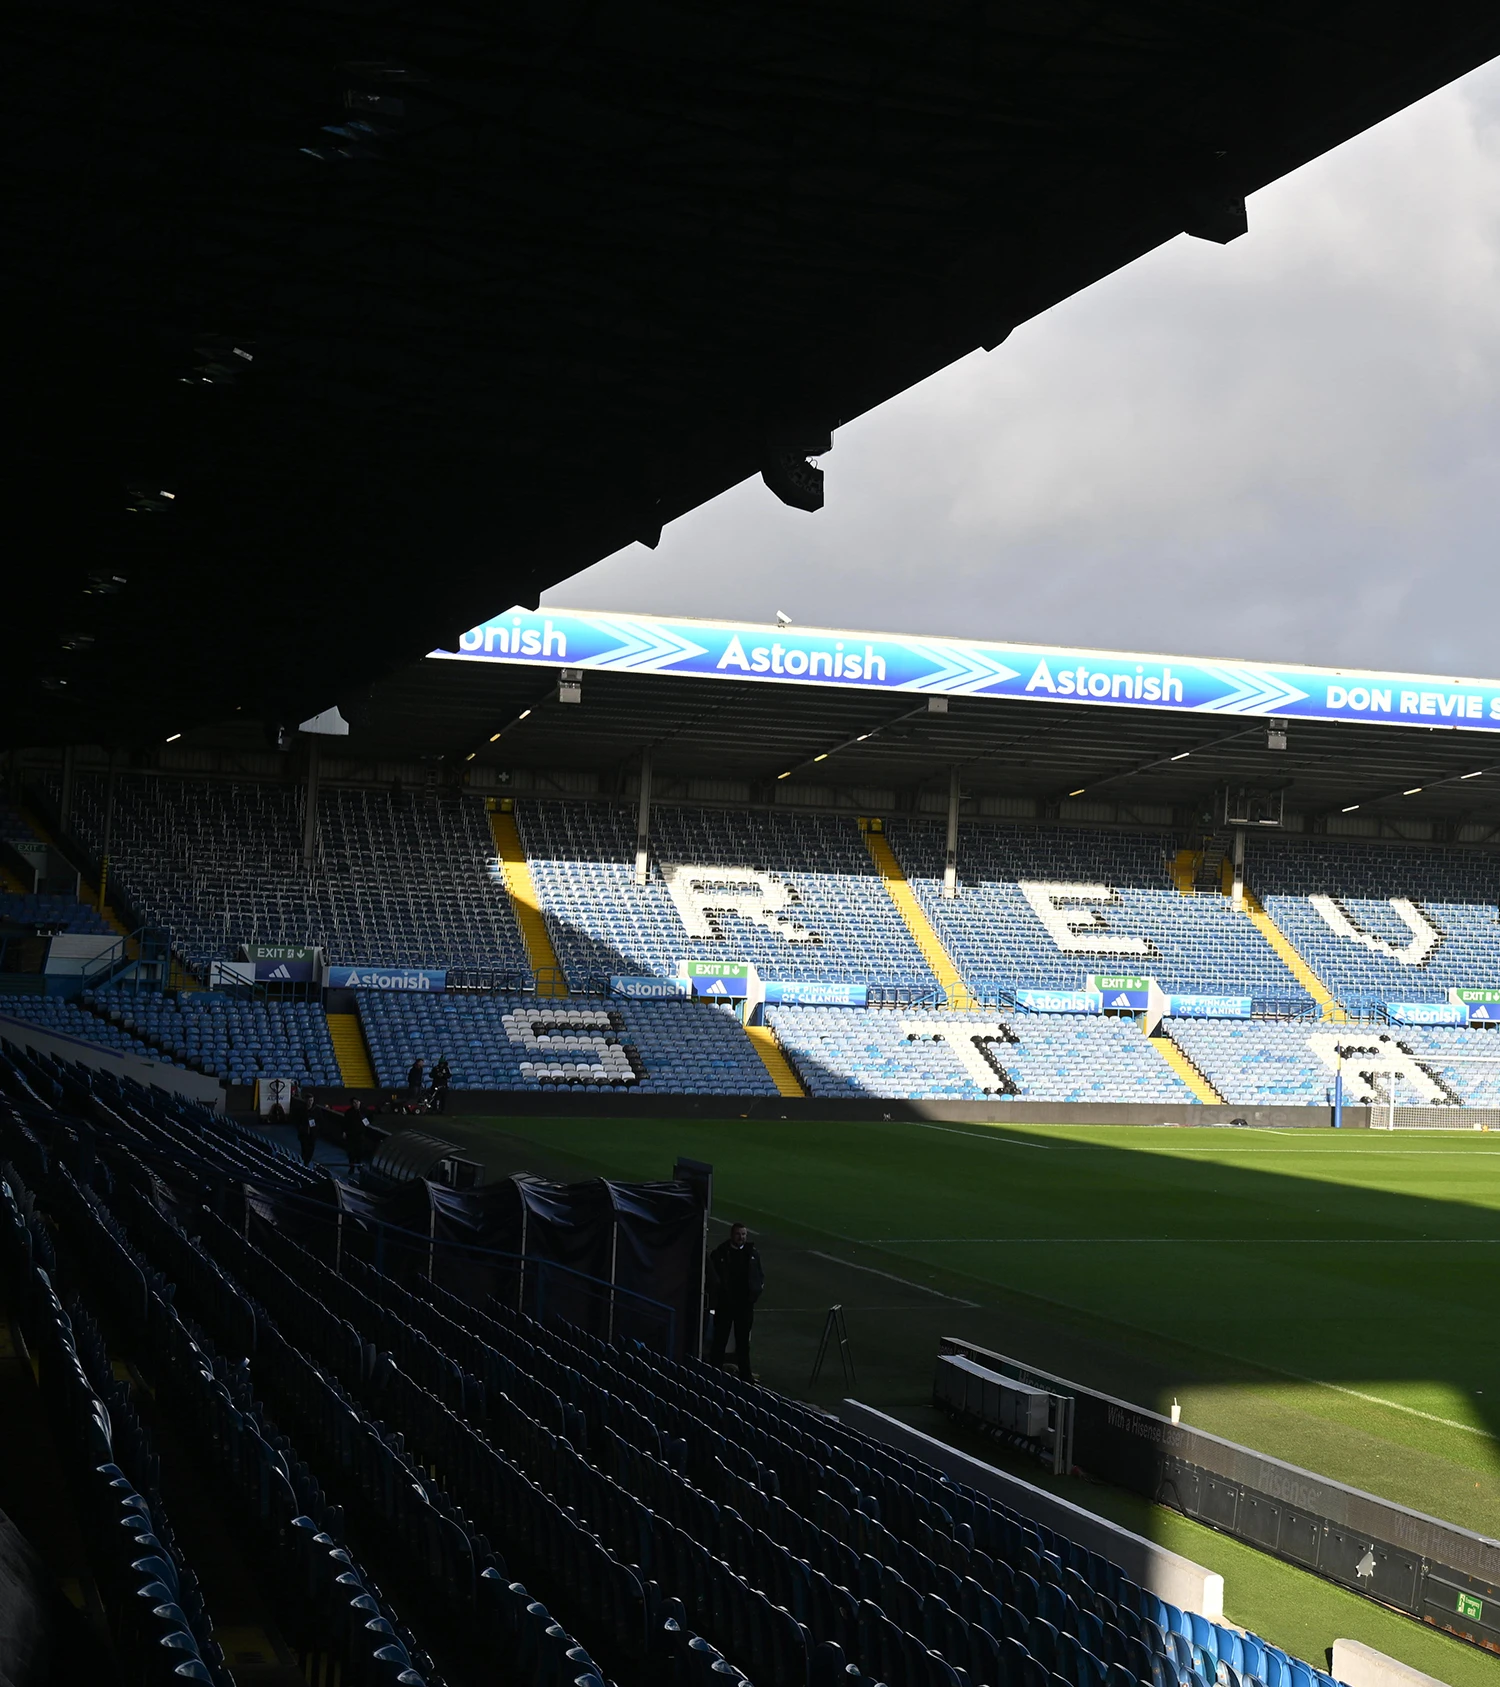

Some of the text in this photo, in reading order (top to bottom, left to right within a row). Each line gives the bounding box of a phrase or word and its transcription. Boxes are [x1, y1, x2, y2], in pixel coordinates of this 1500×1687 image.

[717, 635, 887, 681] Astonish
[1025, 658, 1183, 702] Astonish
[1326, 685, 1392, 713] DON
[1400, 690, 1483, 719] REVIE
[257, 947, 285, 958] EXIT
[695, 964, 722, 976] EXIT
[345, 970, 430, 990] Astonish
[612, 980, 686, 997] Astonish
[1101, 978, 1125, 989] EXIT
[782, 985, 850, 996] THE PINNACLE
[782, 994, 850, 1004] OF CLEANING
[1462, 991, 1484, 1002] EXIT
[1023, 992, 1096, 1012] Astonish
[1394, 1005, 1461, 1023] Astonish
[1107, 1405, 1125, 1429] With
[1132, 1416, 1161, 1442] Hisense
[1259, 1462, 1318, 1506] Hisense
